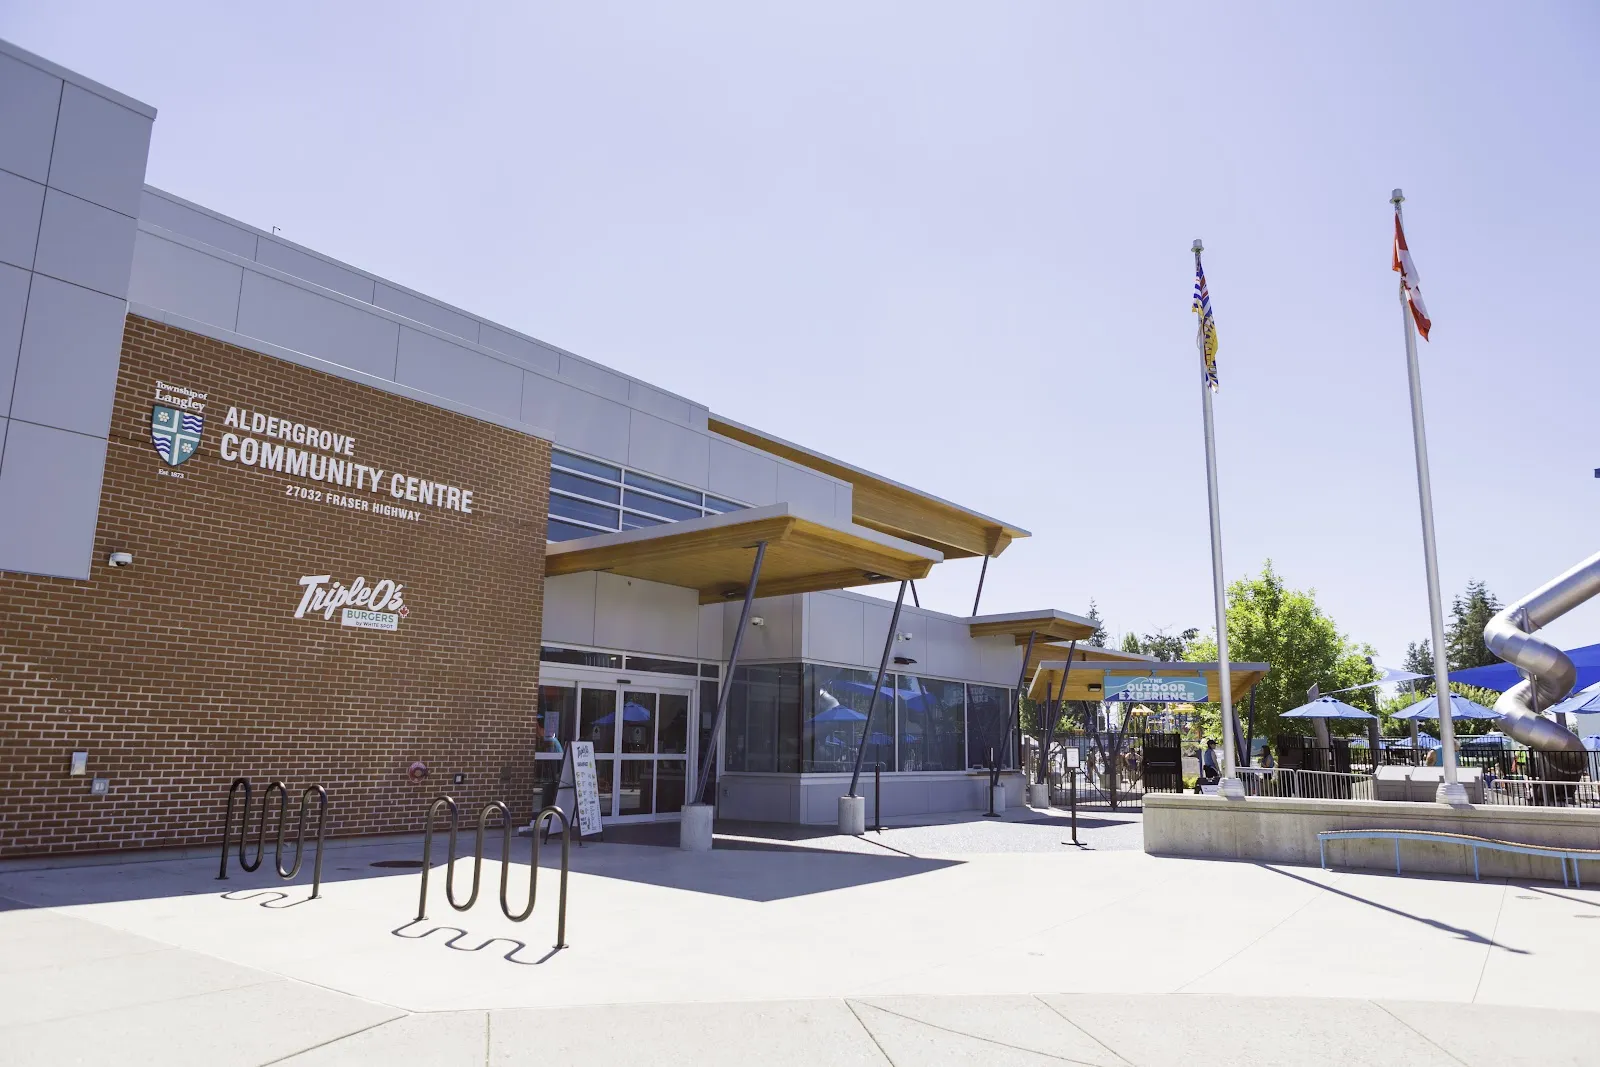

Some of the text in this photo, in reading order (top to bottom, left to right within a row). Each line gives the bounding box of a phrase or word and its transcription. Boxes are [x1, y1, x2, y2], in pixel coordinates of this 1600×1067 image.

[155, 389, 205, 413] Langley
[156, 381, 198, 398] Township
[224, 406, 355, 457] ALDERGROVE
[220, 432, 473, 514] COMMUNITY CENTRE
[286, 485, 421, 522] 27032 FRASER HIGHWAY
[347, 610, 394, 623] BURGERS
[1118, 692, 1195, 700] EXPERIENCE
